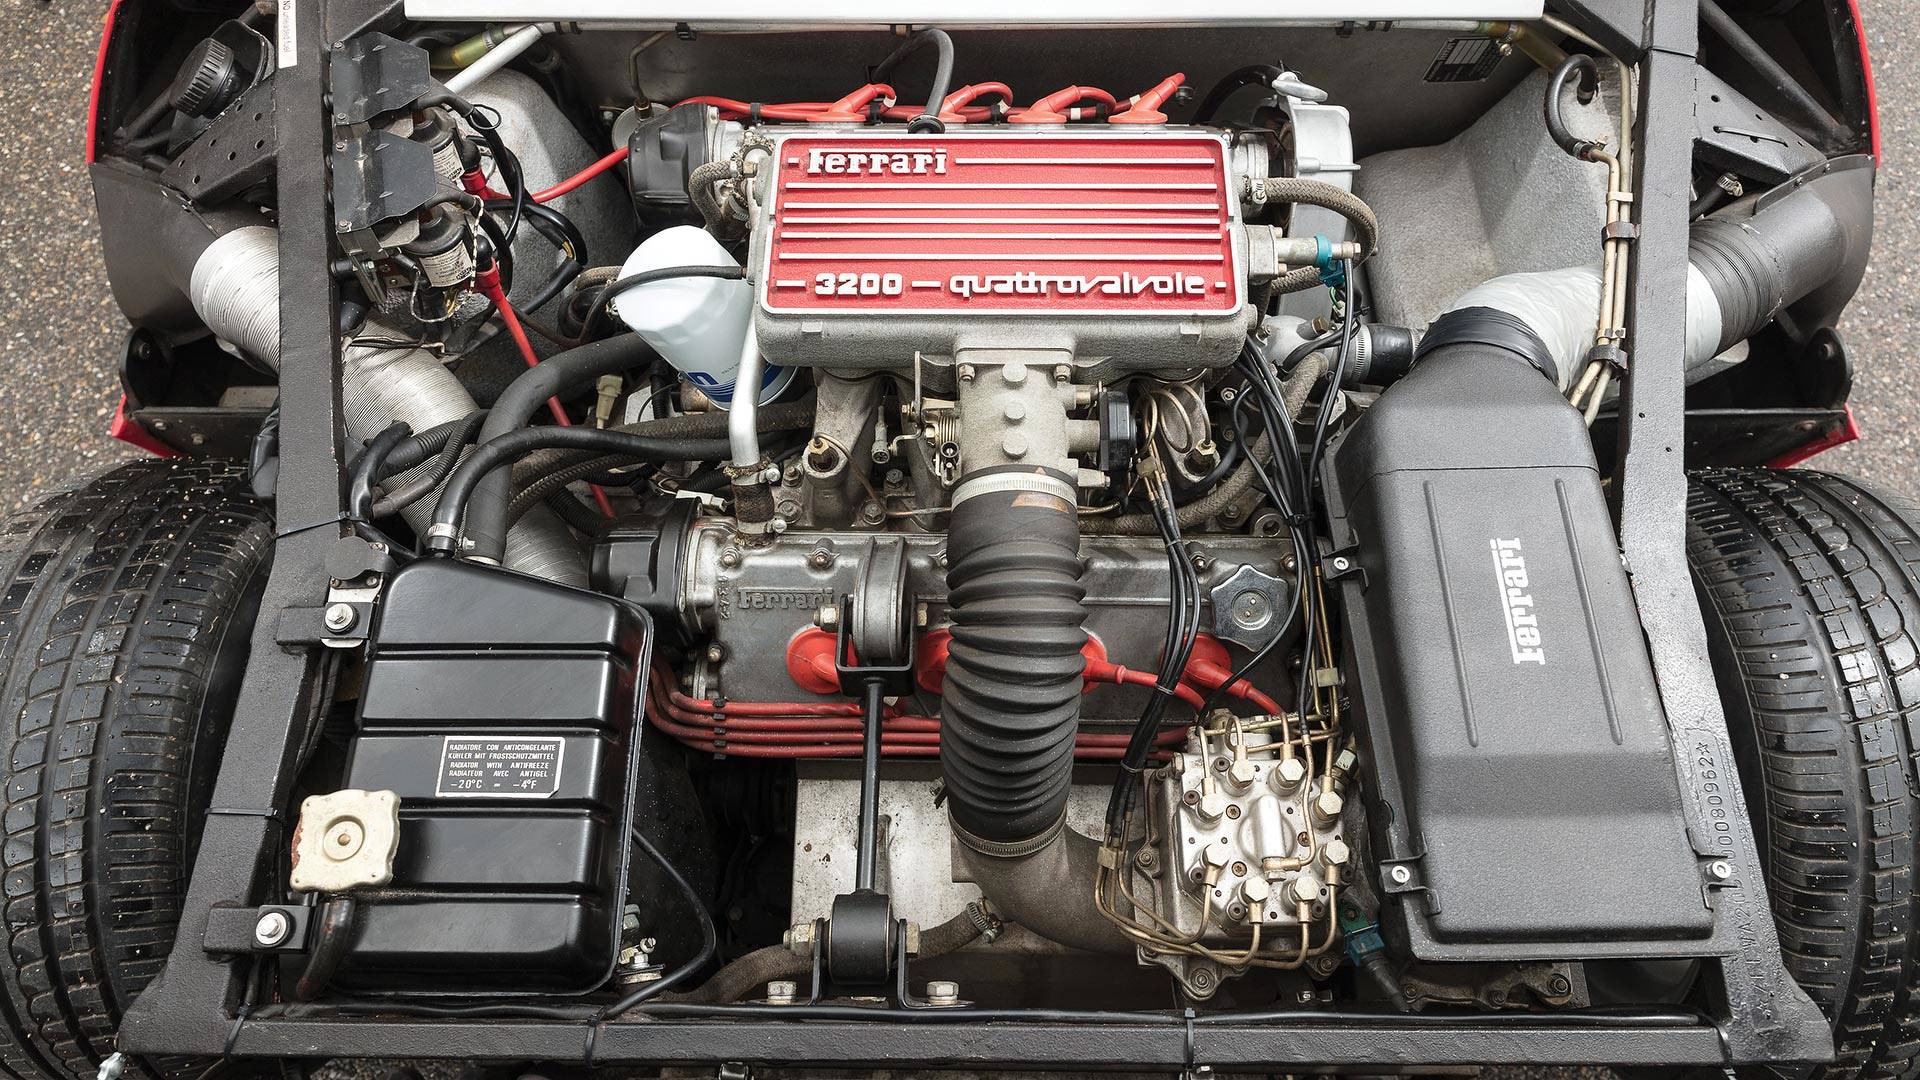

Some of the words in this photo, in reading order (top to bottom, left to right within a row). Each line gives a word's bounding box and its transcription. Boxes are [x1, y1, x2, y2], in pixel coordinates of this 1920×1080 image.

[807, 148, 947, 175] Ferrari
[815, 273, 903, 296] 3200
[949, 272, 1206, 299] quattrovalvole
[738, 587, 834, 610] Ferrari
[1489, 537, 1546, 666] Ferrari
[519, 770, 548, 778] ANTIGEL
